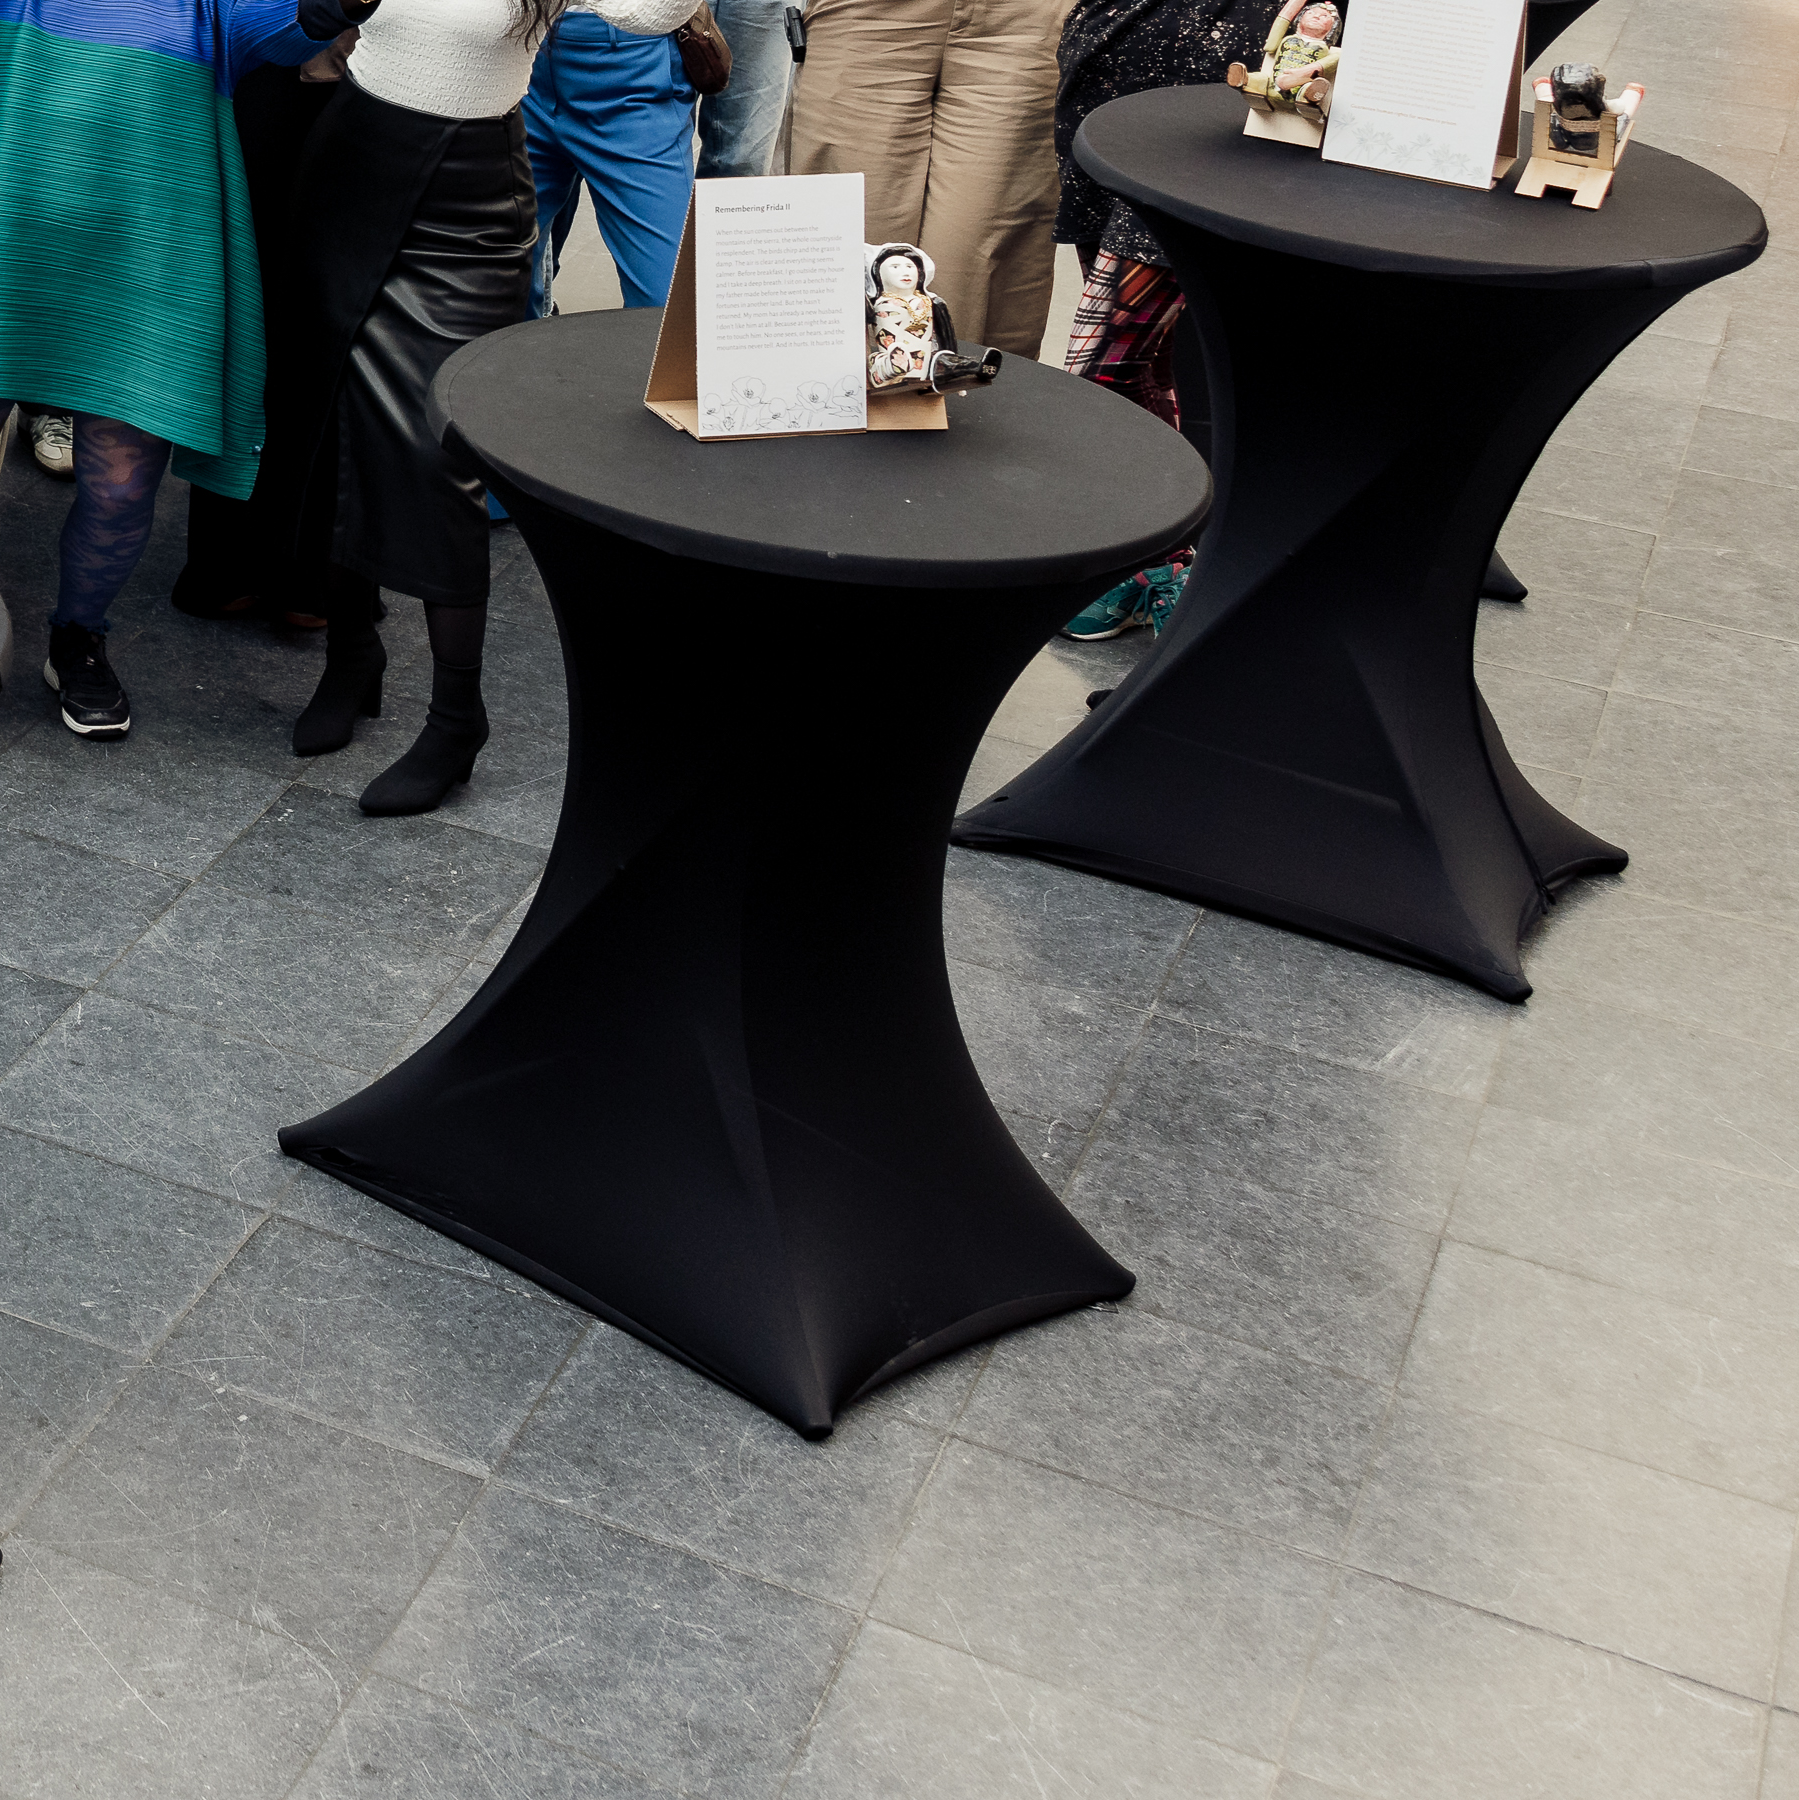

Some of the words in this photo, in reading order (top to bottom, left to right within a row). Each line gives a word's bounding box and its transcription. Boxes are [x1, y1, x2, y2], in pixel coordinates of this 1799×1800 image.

[715, 203, 765, 215] Remembering
[766, 203, 784, 211] Frida
[786, 202, 791, 210] II
[810, 235, 843, 244] countryside
[783, 247, 798, 256] chirp
[786, 256, 816, 266] everything
